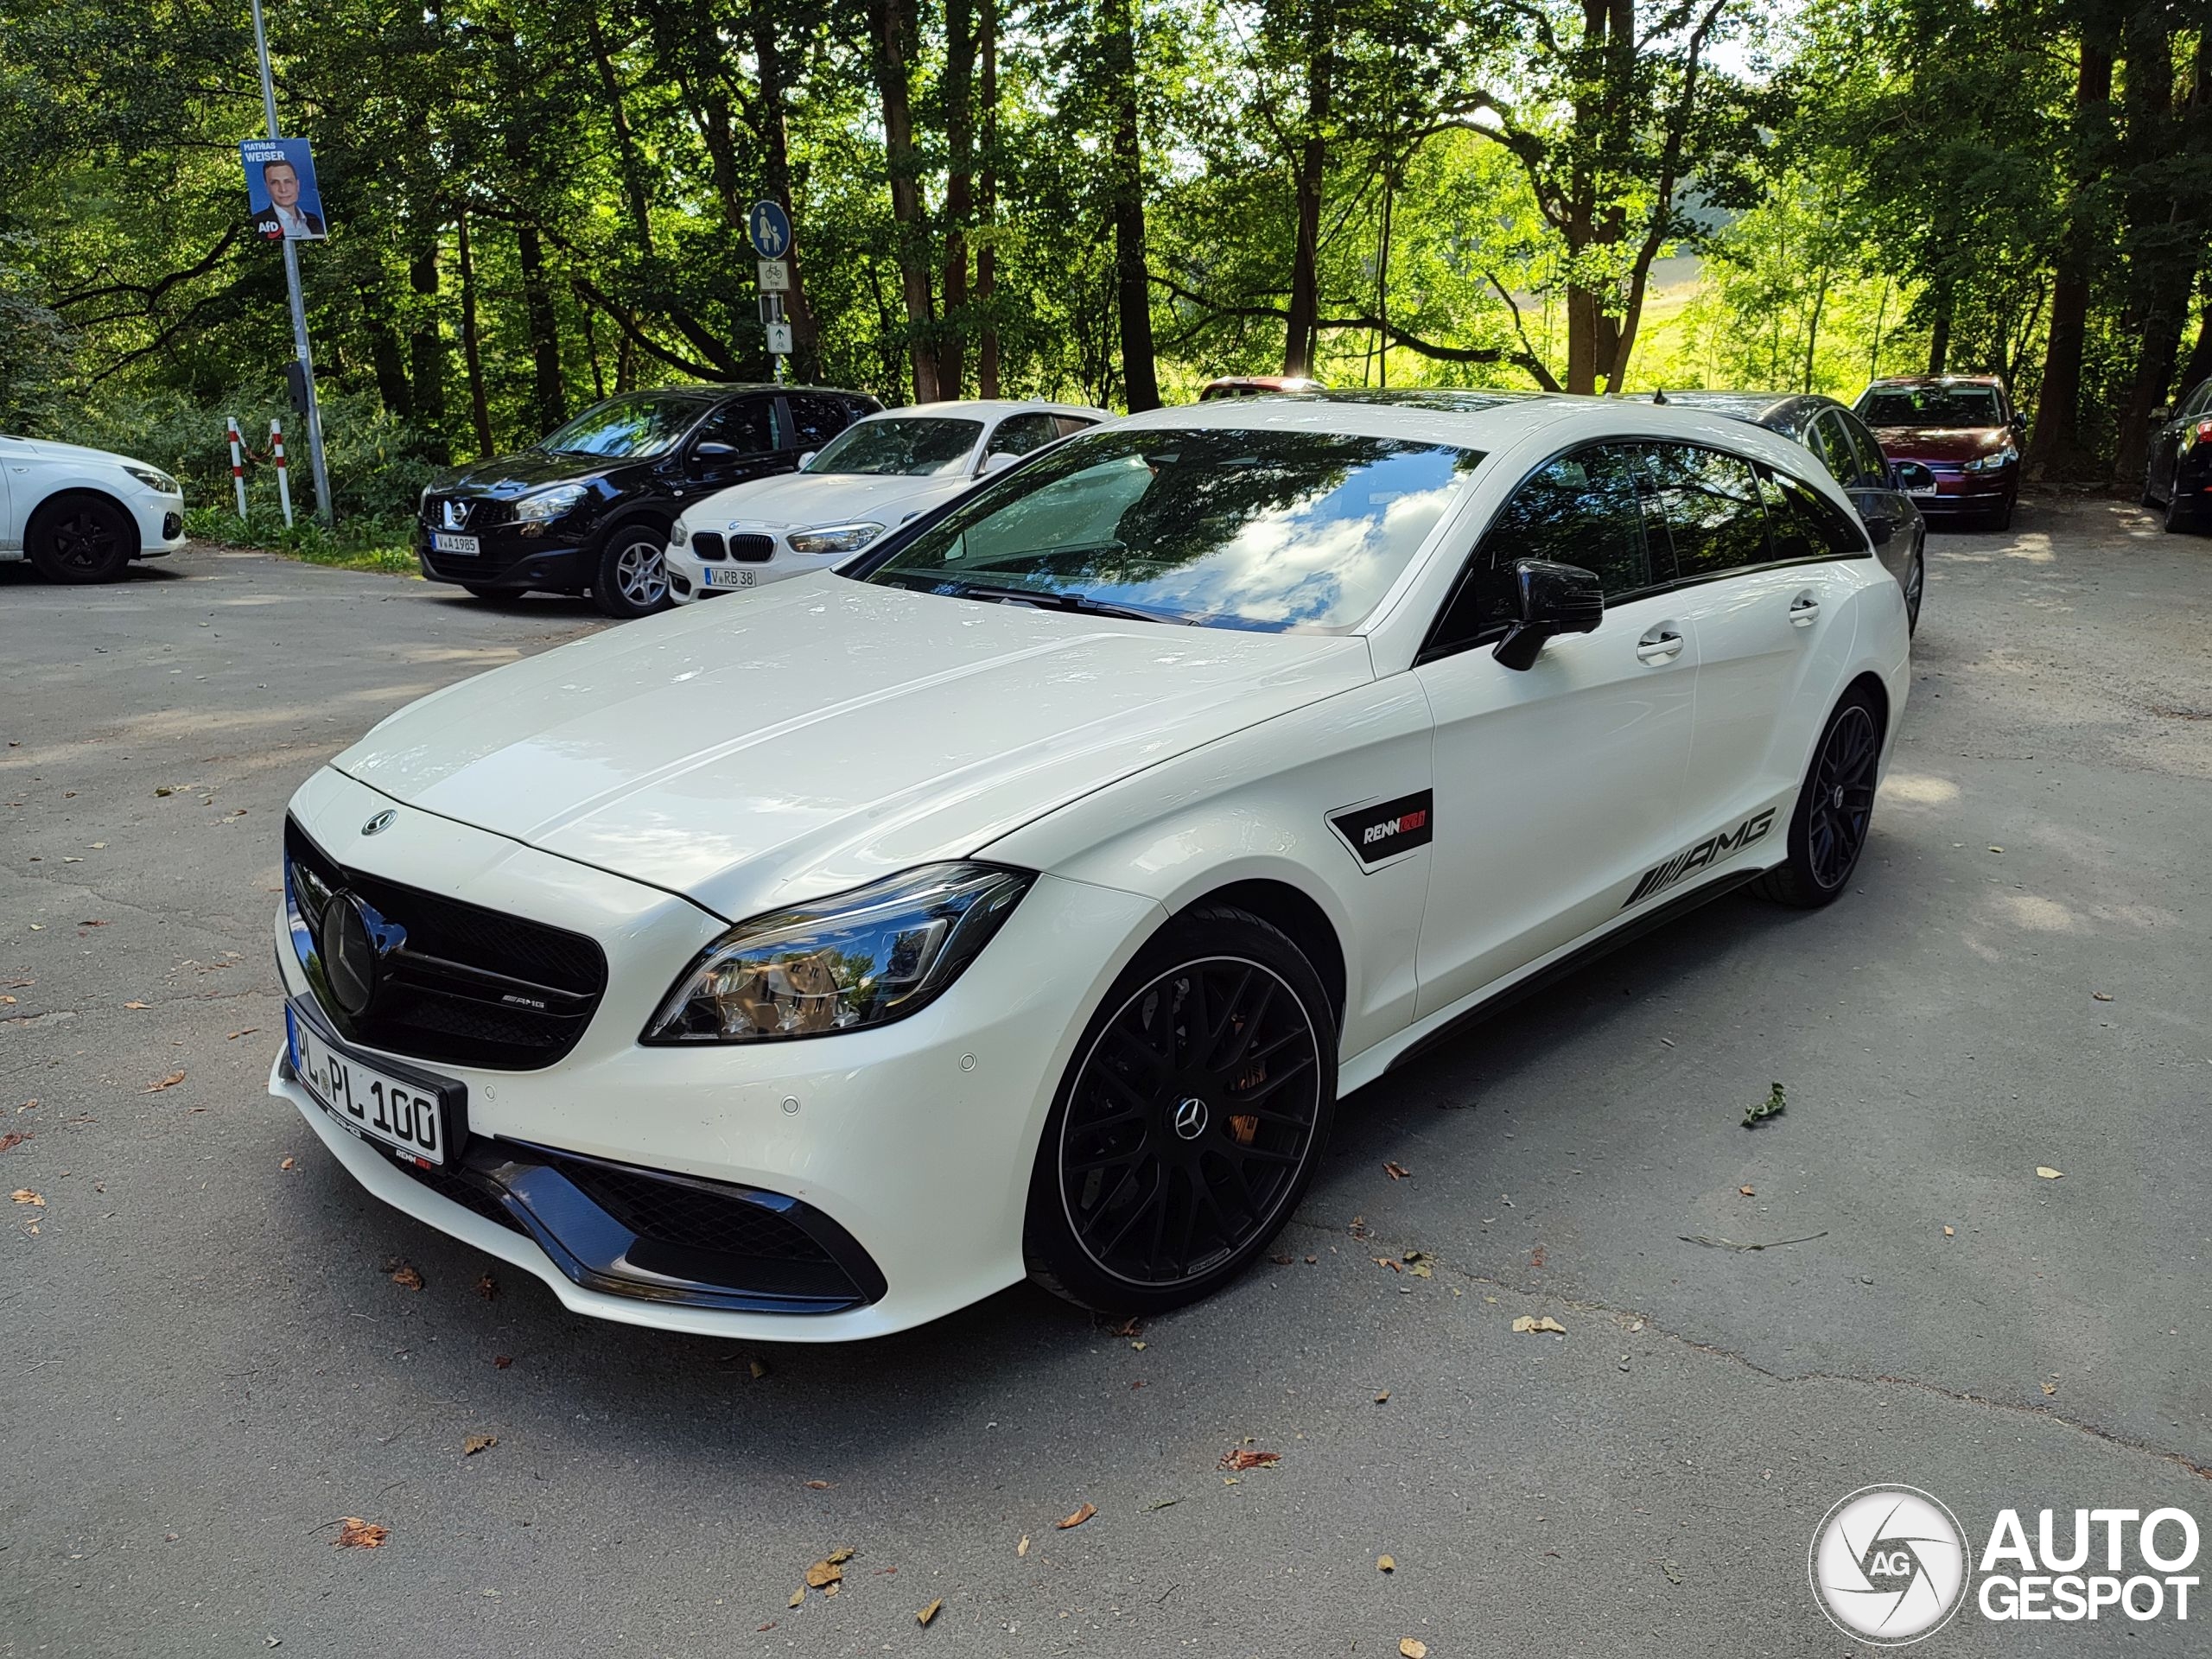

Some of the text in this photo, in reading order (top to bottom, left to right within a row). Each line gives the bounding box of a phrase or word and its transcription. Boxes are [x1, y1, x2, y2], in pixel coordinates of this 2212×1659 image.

[243, 142, 276, 151] MATHIAS
[245, 150, 286, 162] WEISER
[258, 220, 278, 233] AfD
[438, 536, 443, 548] V
[711, 569, 753, 585] V RB 38
[296, 1020, 436, 1151] PL PL 100
